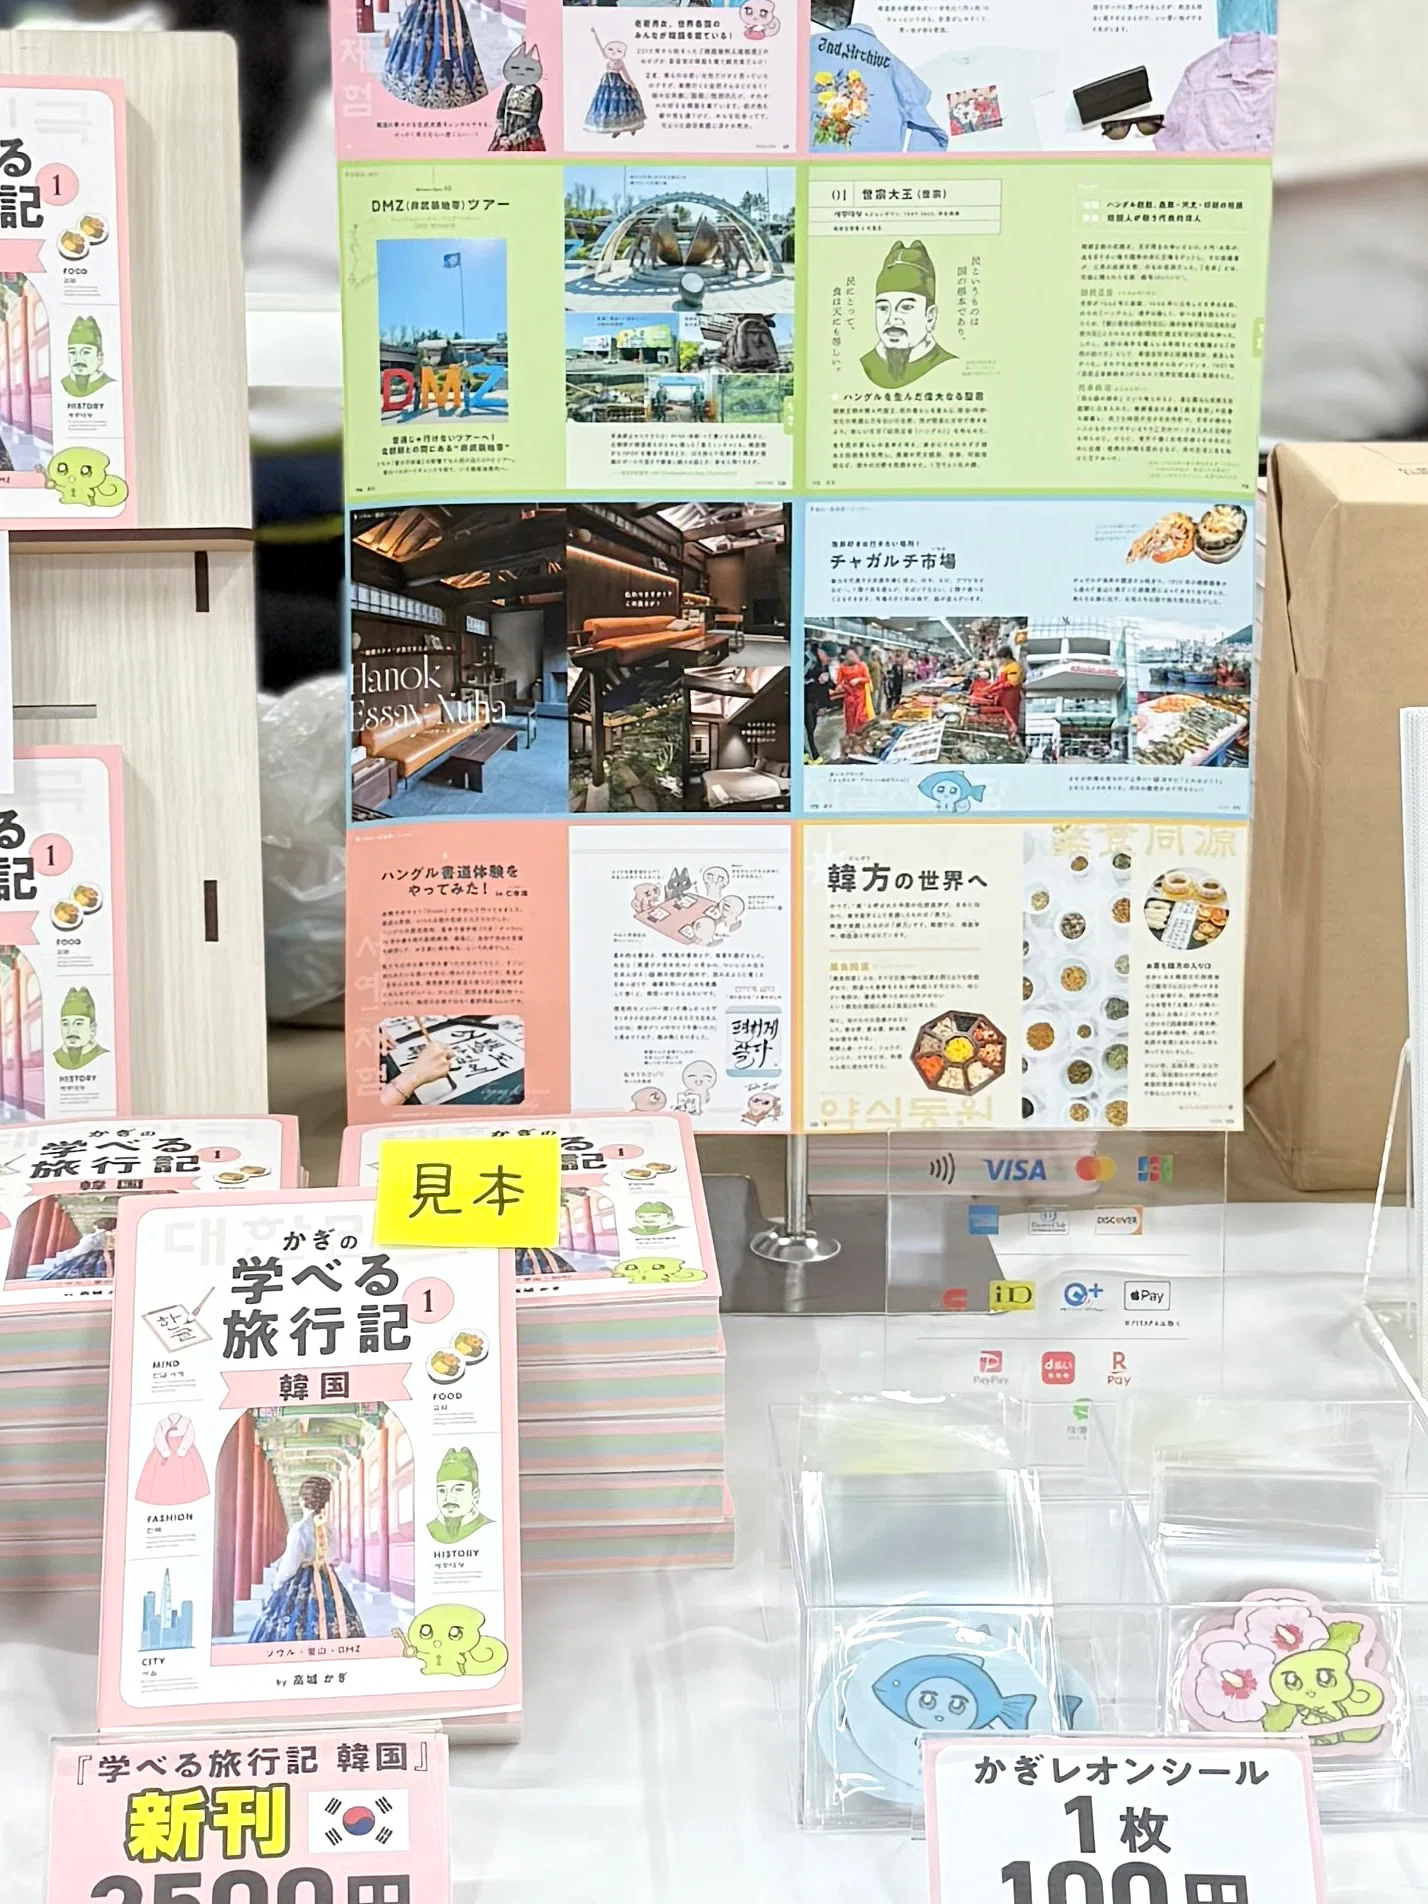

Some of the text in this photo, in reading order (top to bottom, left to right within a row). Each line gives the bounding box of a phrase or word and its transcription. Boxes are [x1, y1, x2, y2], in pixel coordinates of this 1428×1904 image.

[970, 256, 981, 326] 民というものは
[381, 364, 508, 412] DMZ
[831, 552, 956, 570] チャガルチ市場
[382, 865, 518, 880] ハングル書道体験を
[828, 862, 988, 892] 韓方の世界へ
[408, 882, 488, 896] やってみた！
[984, 1158, 1047, 1182] VISA
[408, 1163, 525, 1218] 見本
[1097, 1216, 1138, 1225] DISCOVER
[231, 1254, 399, 1304] 学べる
[995, 1285, 1164, 1304] iD Pay
[223, 1304, 411, 1360] 旅行記
[153, 1360, 181, 1369] MIND
[974, 1376, 1009, 1385] PayPay
[1108, 1375, 1131, 1386] Pay
[433, 1392, 463, 1401] FOOD
[147, 1513, 193, 1524] FASHION
[433, 1550, 479, 1559] HISTORY
[142, 1656, 166, 1666] CITY
[293, 1672, 347, 1686] 高城 かぎ
[76, 1742, 428, 1785] 『学べる旅行記 韓国』
[974, 1754, 1269, 1786] かぎレオンシール
[125, 1783, 291, 1863] 新刊
